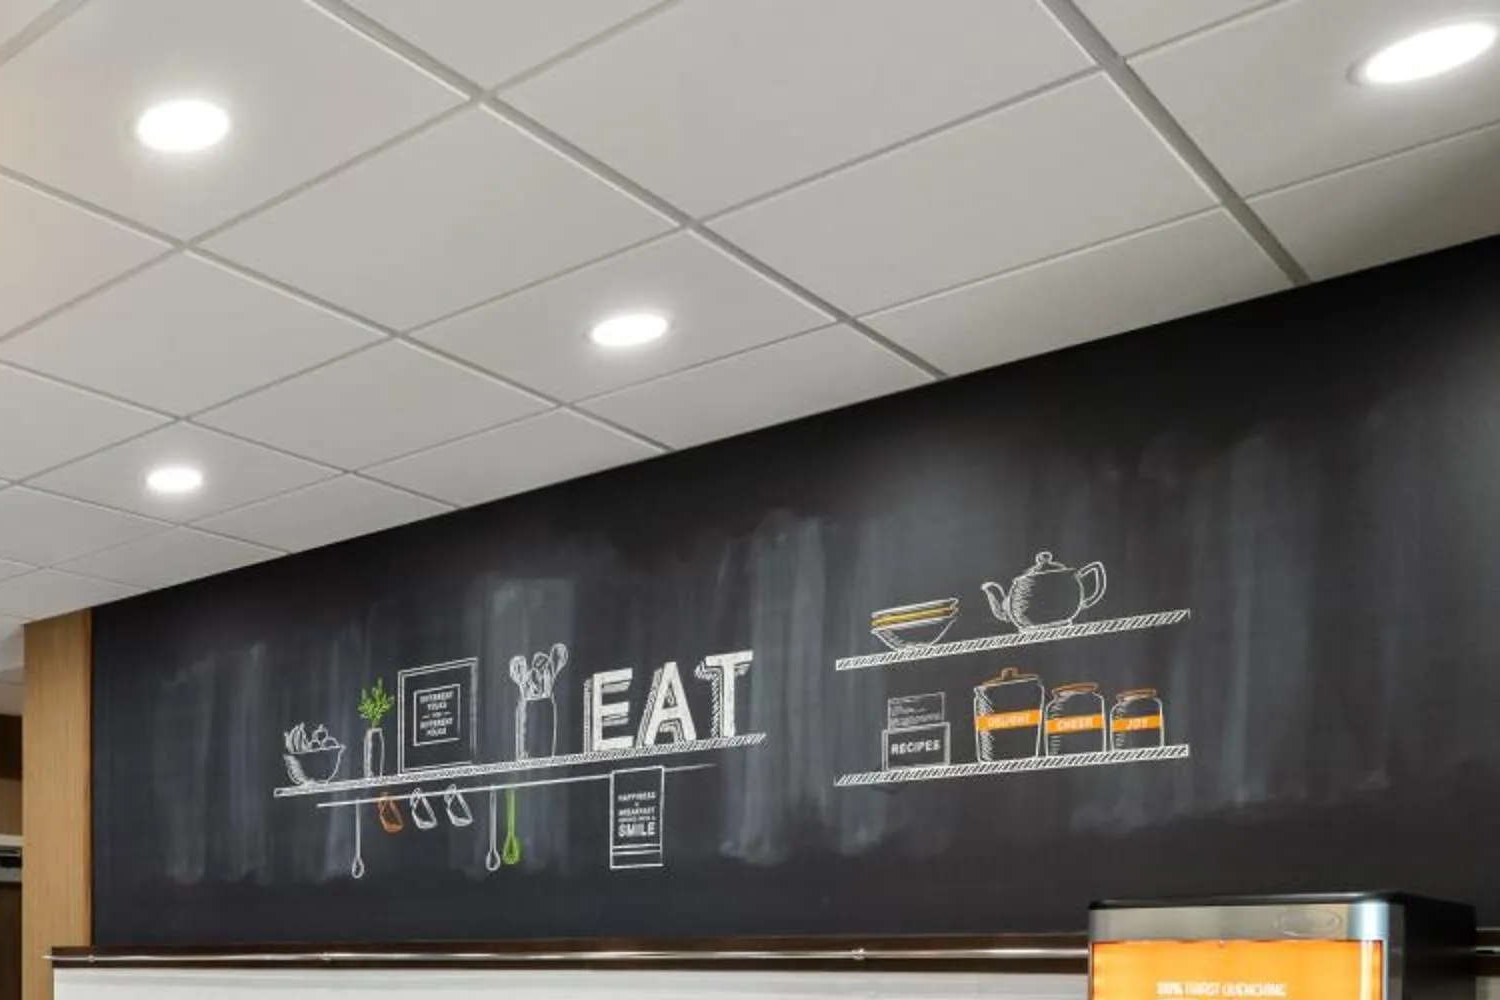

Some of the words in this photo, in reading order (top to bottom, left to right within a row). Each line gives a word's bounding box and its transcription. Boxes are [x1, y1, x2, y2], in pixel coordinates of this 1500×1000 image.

[584, 651, 753, 752] EAT
[891, 739, 941, 755] RECIPES
[618, 821, 656, 838] SMILE
